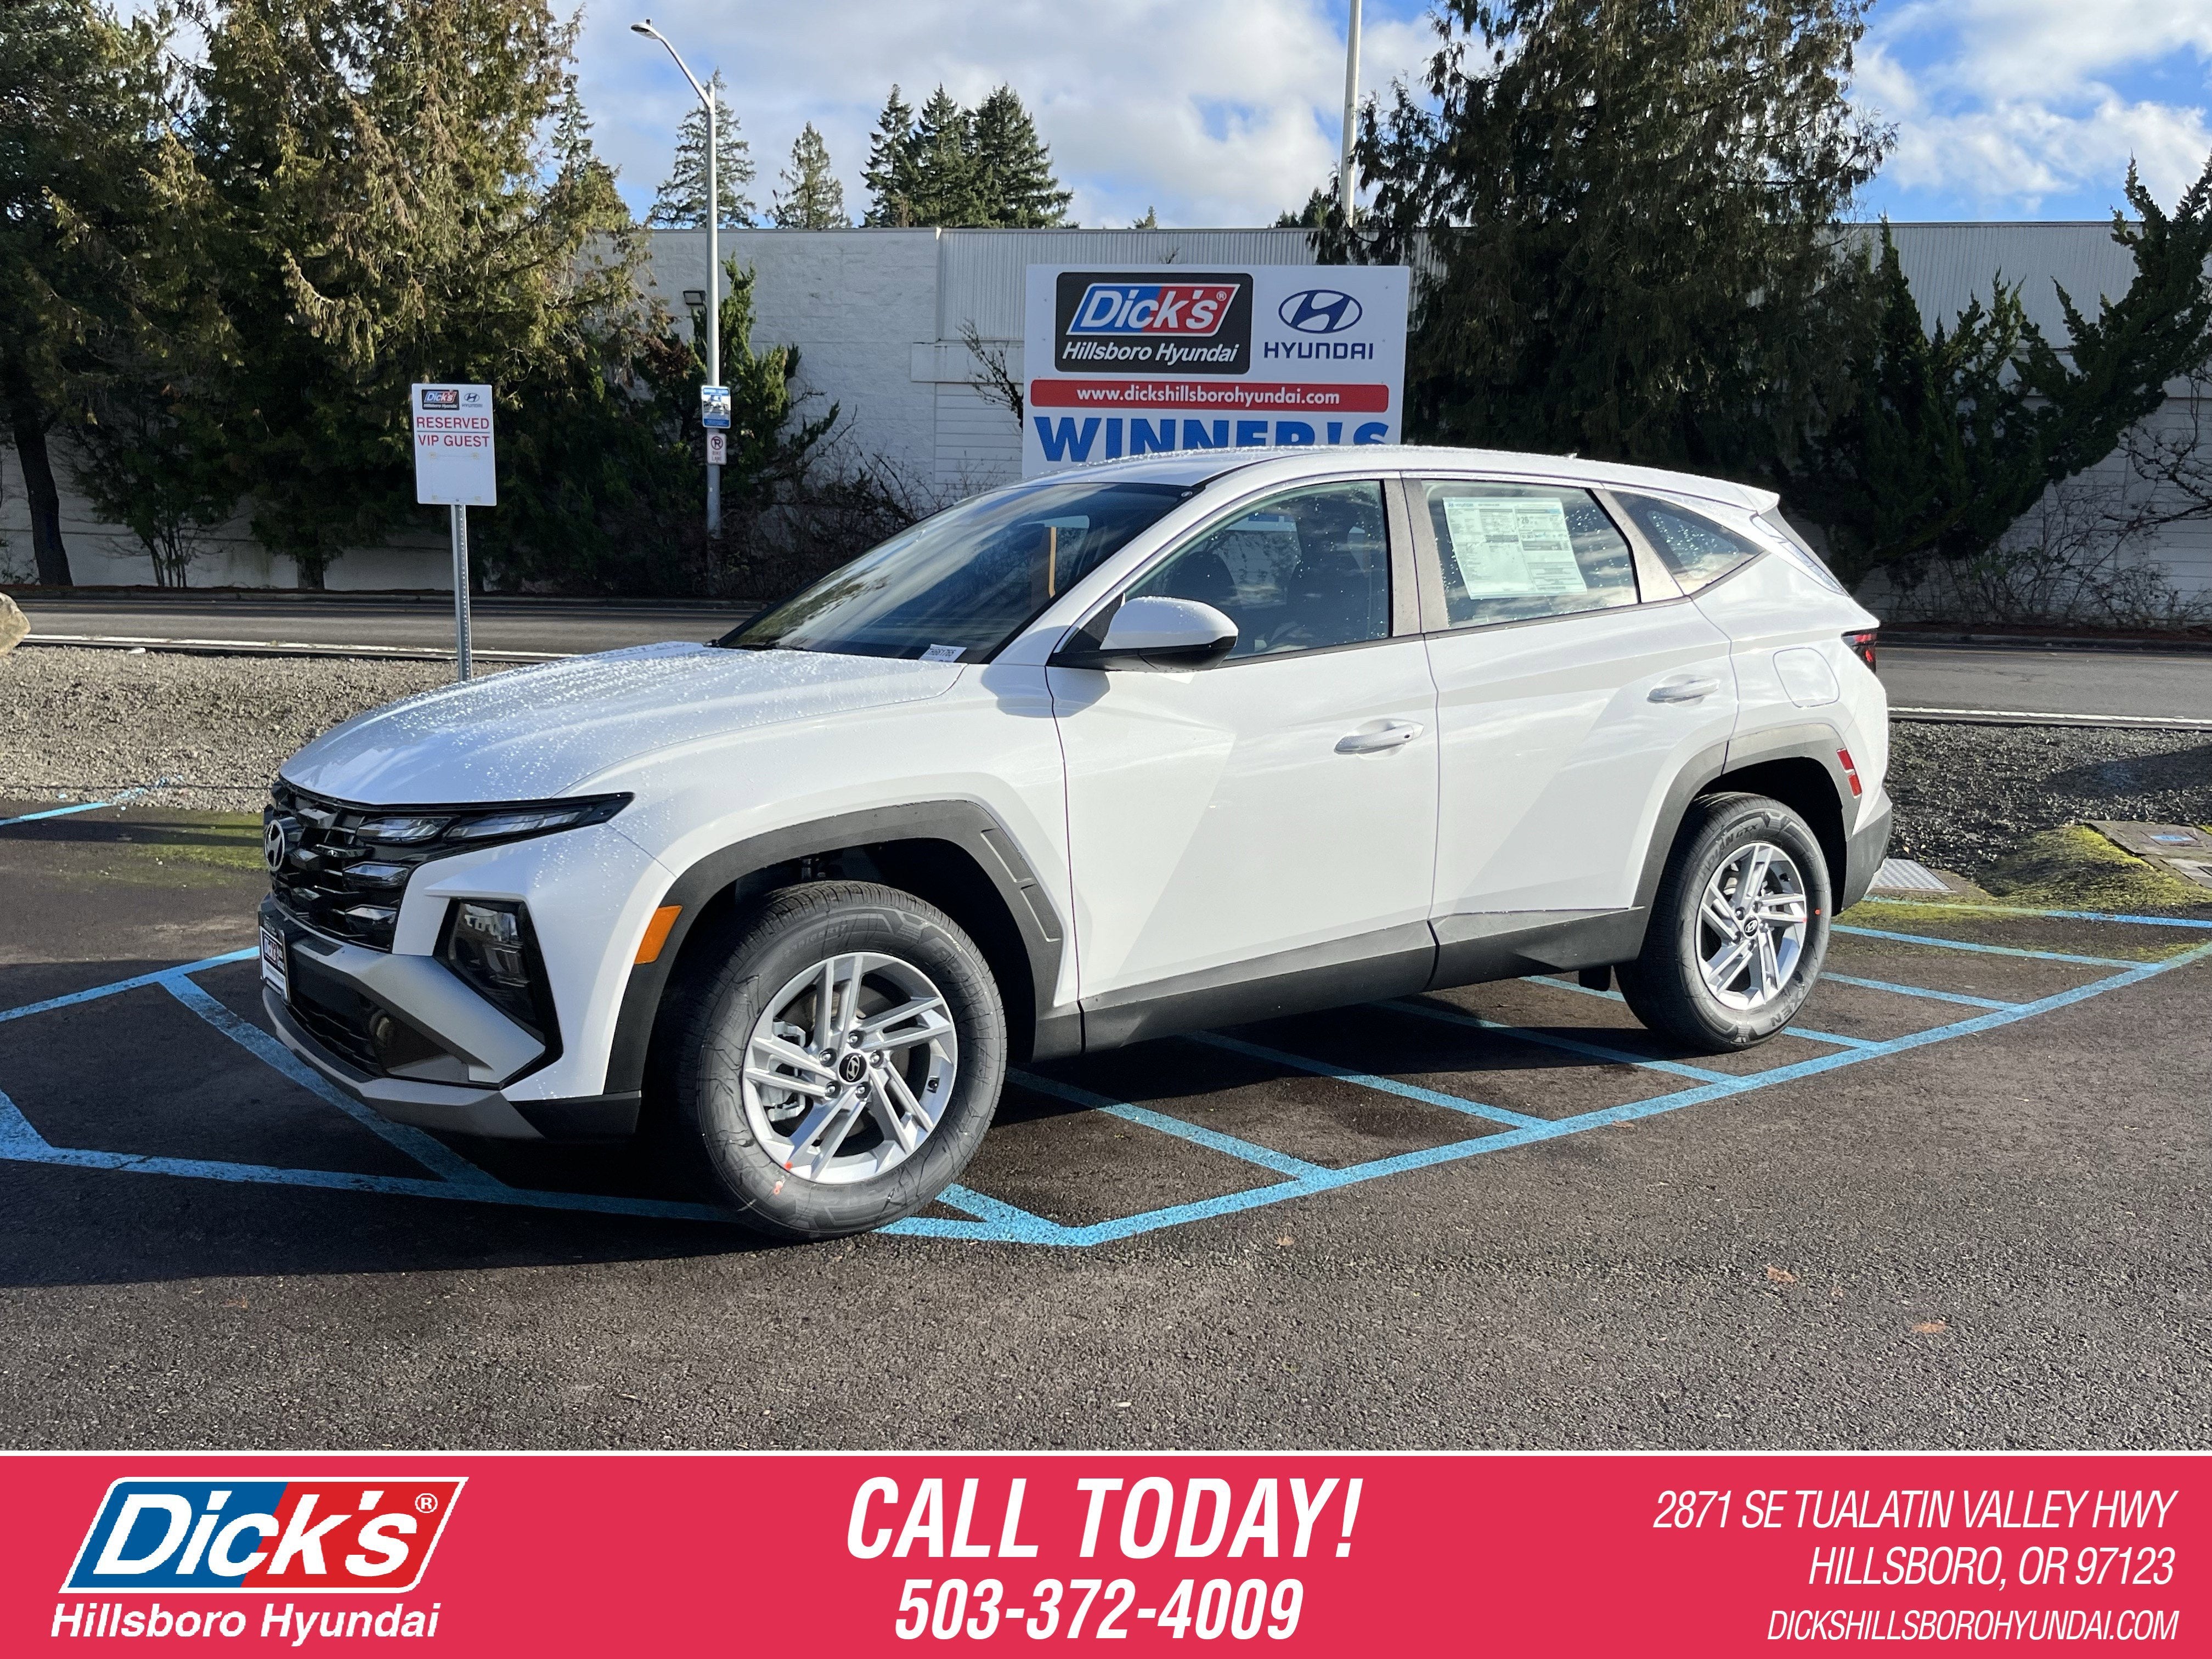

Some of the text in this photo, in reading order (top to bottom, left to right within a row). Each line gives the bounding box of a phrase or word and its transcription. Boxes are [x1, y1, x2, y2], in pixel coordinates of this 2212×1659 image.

[1062, 341, 1239, 366] Hillsboro Hyundai
[1263, 342, 1374, 360] HYUNDAI
[1076, 385, 1340, 407] www.dickshillsborohyundai.com
[416, 417, 489, 430] RESERVED
[418, 435, 490, 447] VIP GUEST
